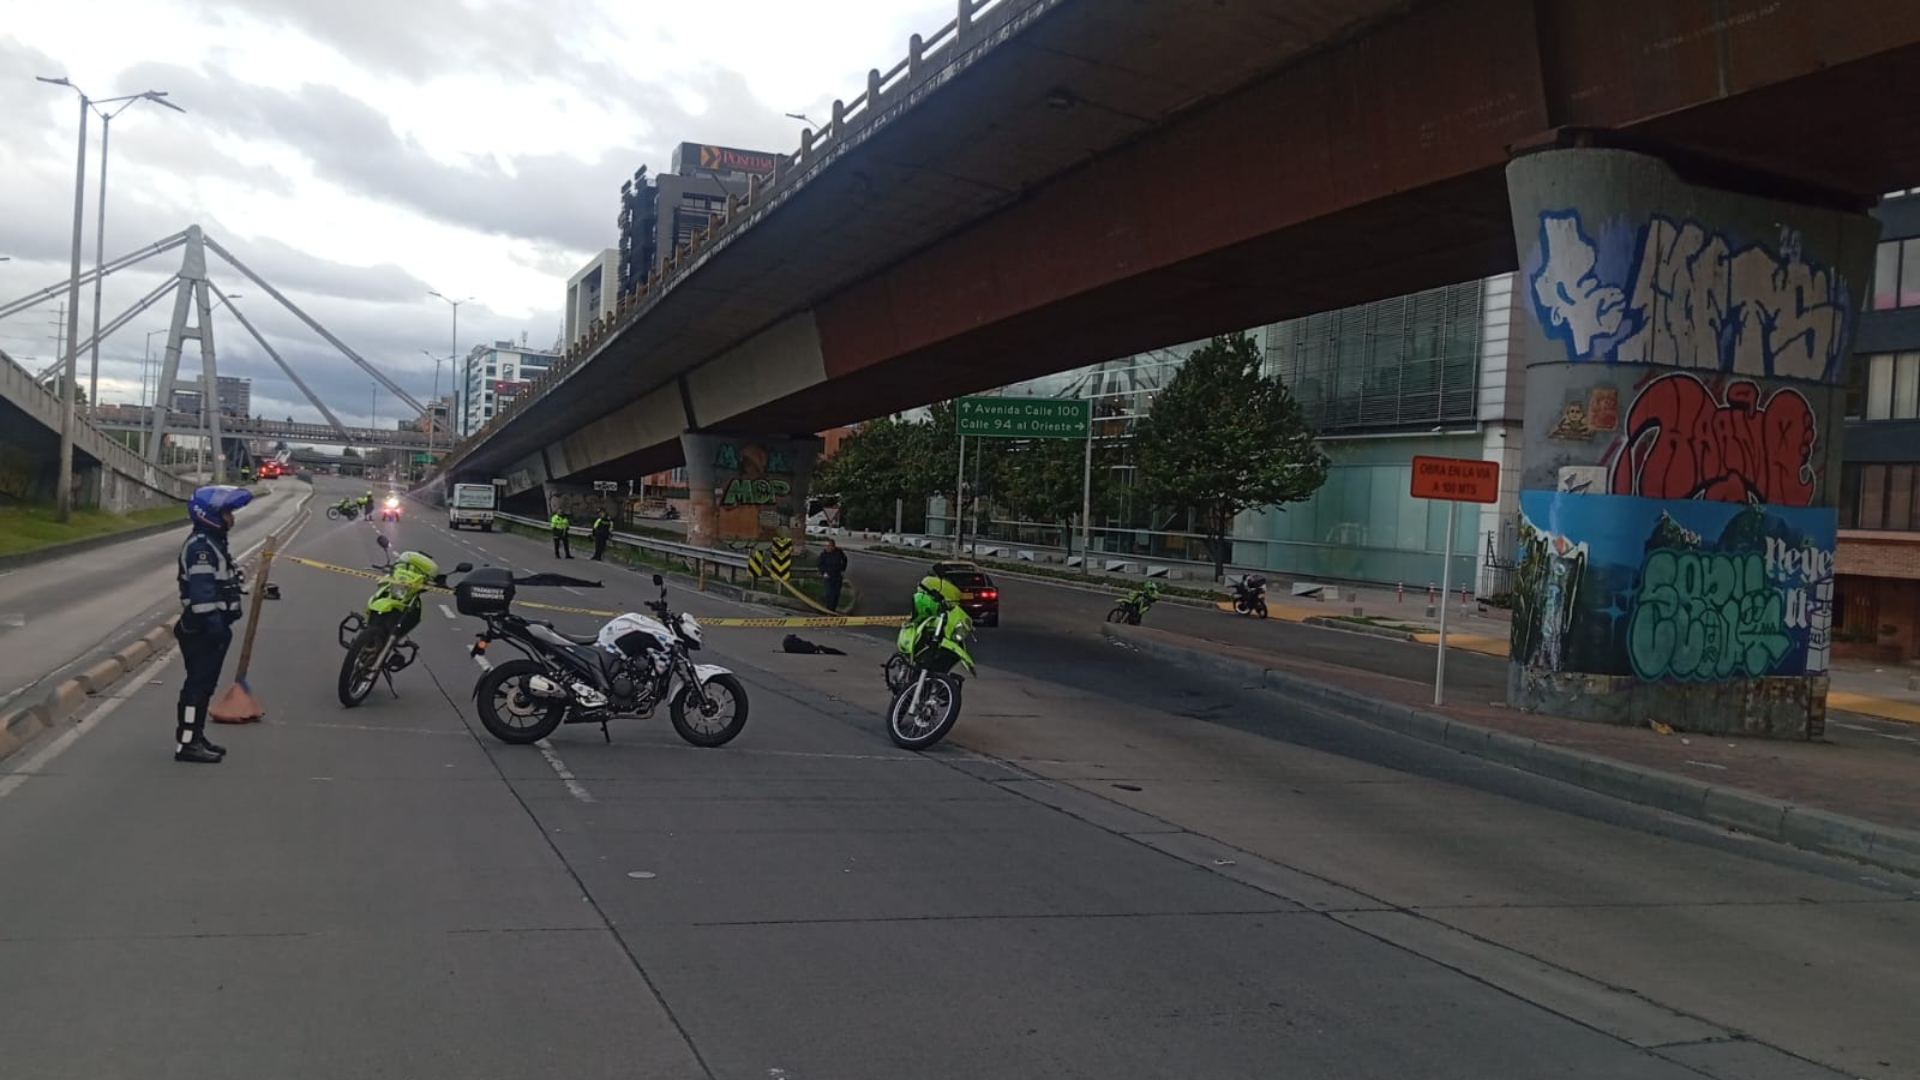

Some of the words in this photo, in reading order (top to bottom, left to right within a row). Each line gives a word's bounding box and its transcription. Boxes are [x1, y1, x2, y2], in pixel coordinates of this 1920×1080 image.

[975, 403, 1020, 415] Avenida
[1025, 405, 1052, 415] Calle
[1058, 406, 1079, 416] 100
[960, 418, 989, 429] Calle
[994, 419, 1012, 429] 94
[1017, 420, 1027, 430] al
[1031, 421, 1071, 431] Oriente
[1420, 463, 1445, 475] OBRA
[1448, 465, 1460, 476] EN
[1463, 466, 1475, 478] LA
[1432, 482, 1439, 492] A
